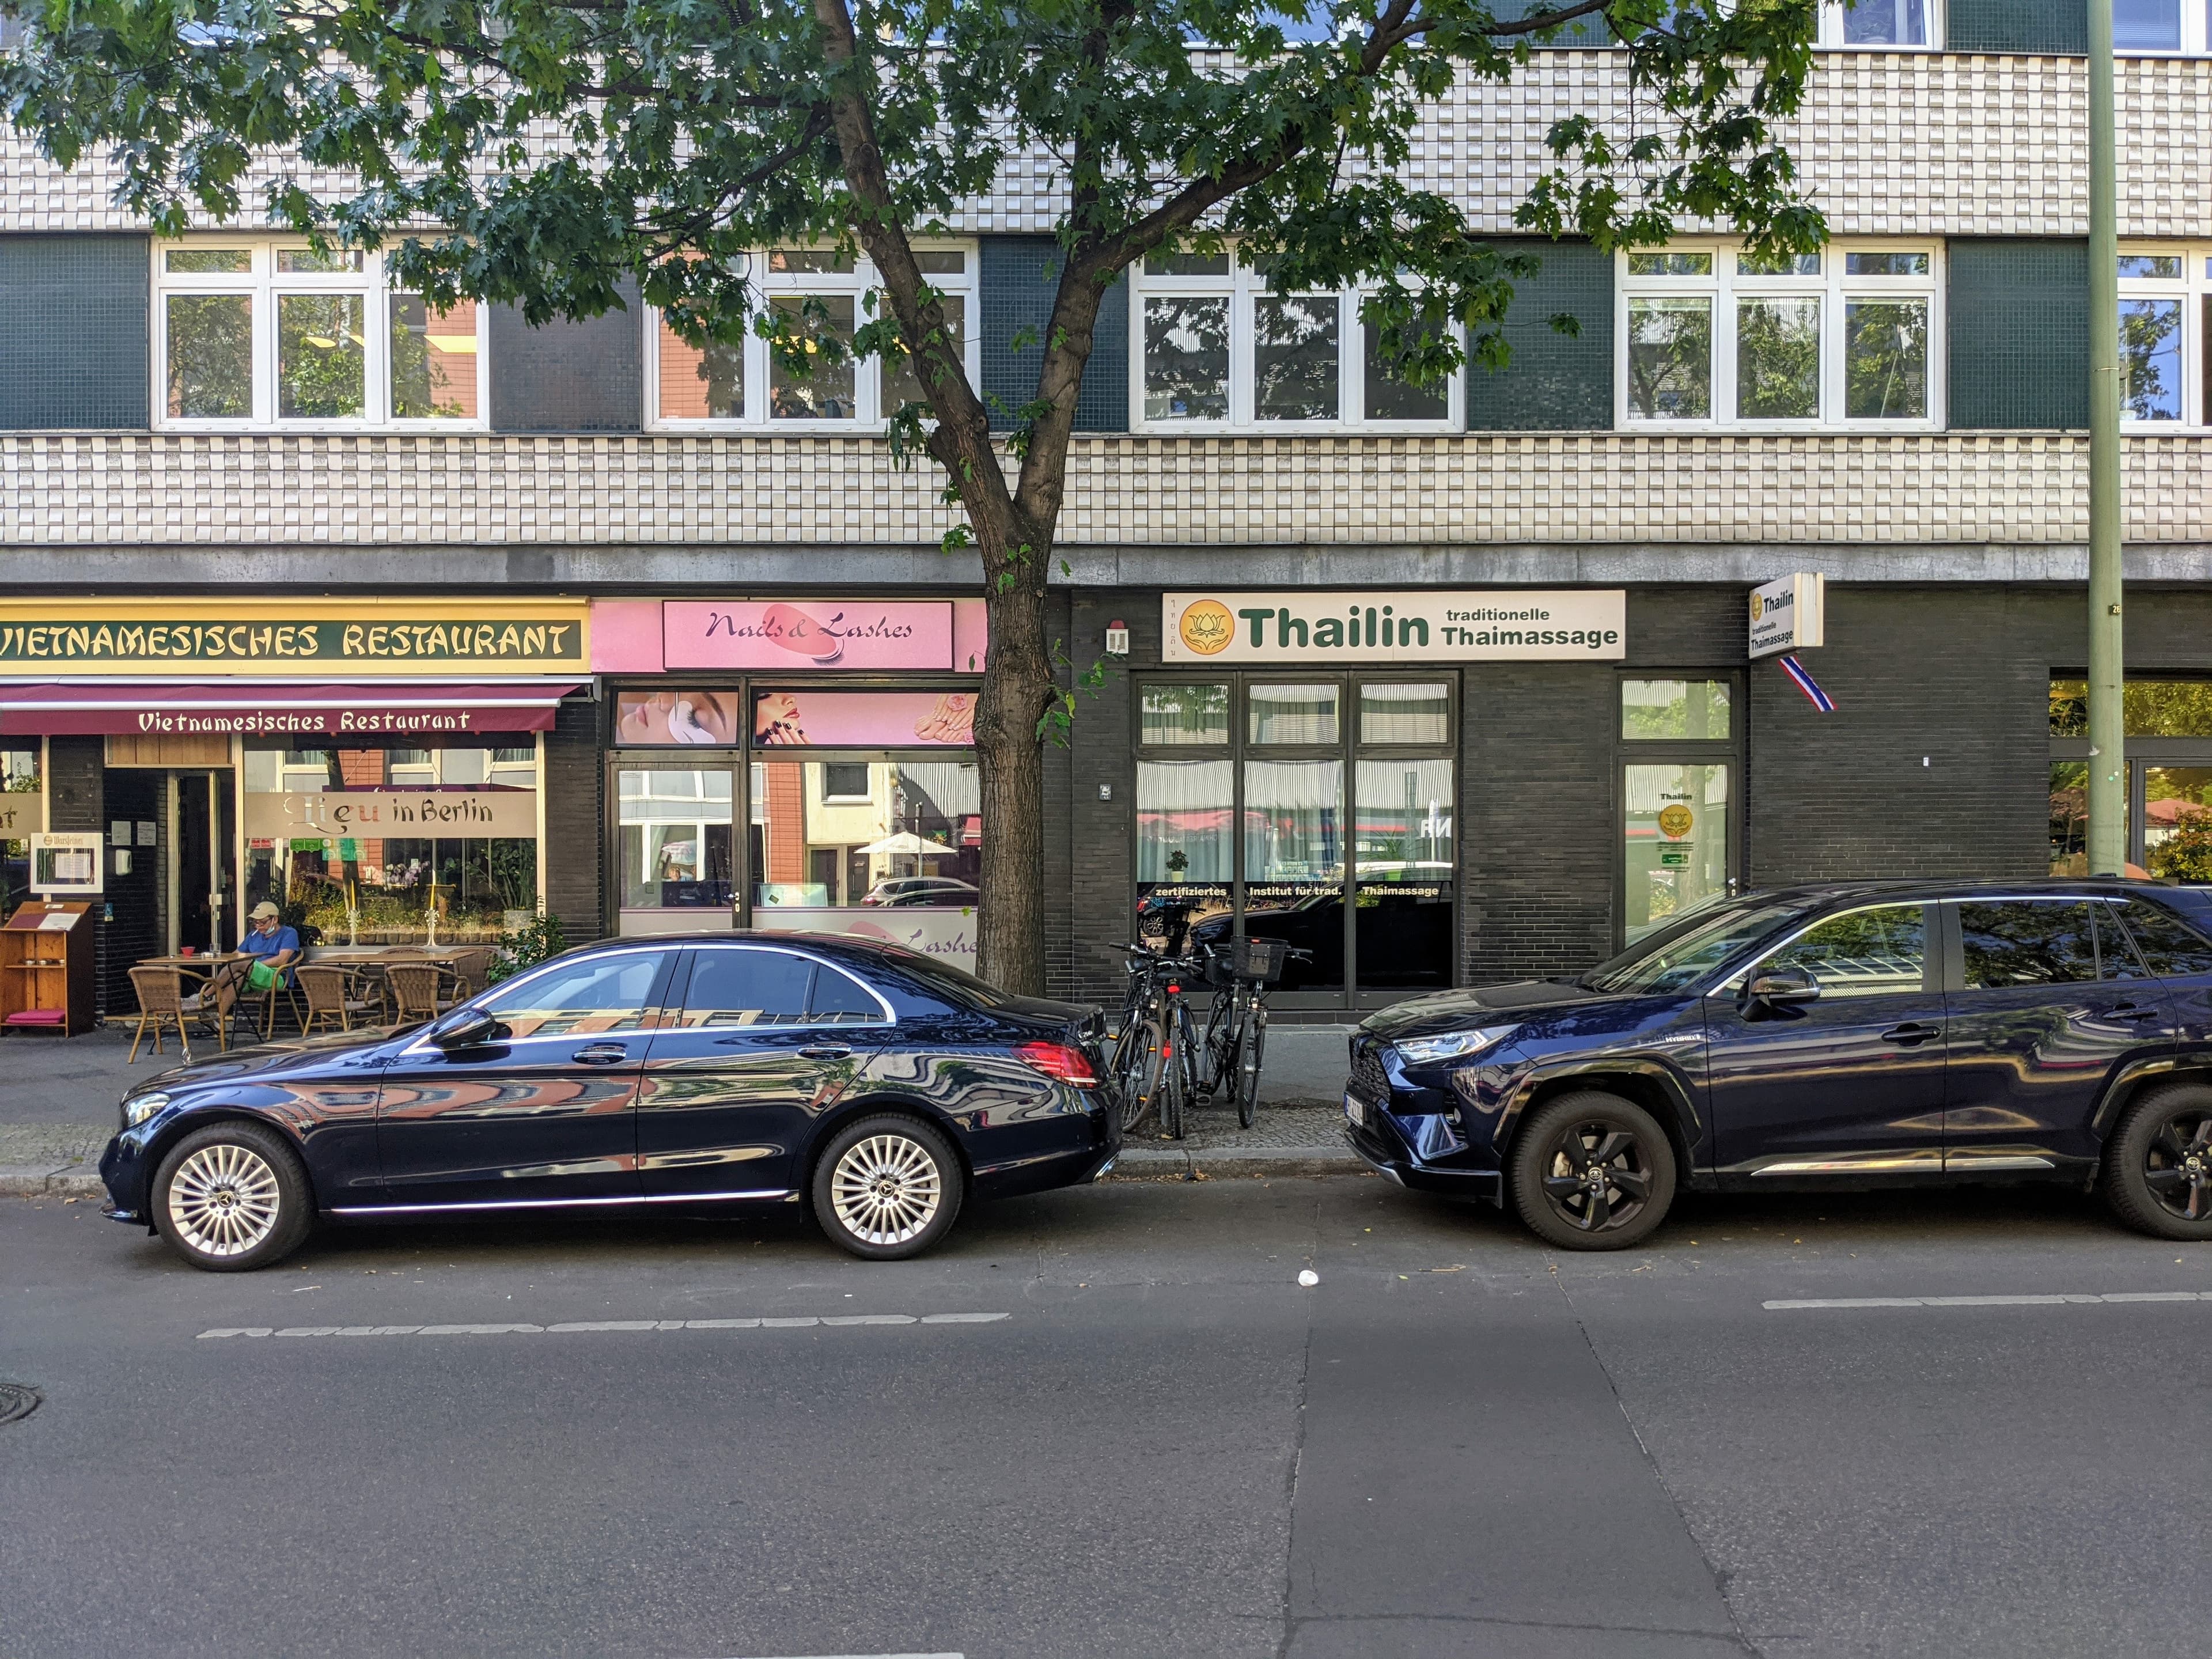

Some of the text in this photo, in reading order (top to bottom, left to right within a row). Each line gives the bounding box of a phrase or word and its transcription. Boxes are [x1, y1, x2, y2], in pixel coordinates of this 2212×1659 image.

[1763, 590, 1793, 613] Thailin
[705, 612, 783, 637] Nails
[818, 612, 912, 638] Lashes
[1446, 608, 1550, 621] traditionelle
[1238, 605, 1429, 648] Thailin
[1441, 626, 1618, 649] Thaimassage
[1752, 622, 1776, 634] traditionelle
[343, 623, 570, 656] RESTAURANT
[1751, 629, 1793, 651] Thaimassage
[139, 711, 470, 731] Vietnamesisches Restaurant
[393, 798, 414, 822] in
[422, 798, 493, 822] Berlin
[1156, 887, 1227, 896] zertifiziertes
[1249, 887, 1292, 896] Institut
[1295, 887, 1312, 896] für
[1314, 887, 1342, 896] trad.
[1362, 887, 1439, 896] Thaimassage
[907, 929, 978, 953] Lashe
